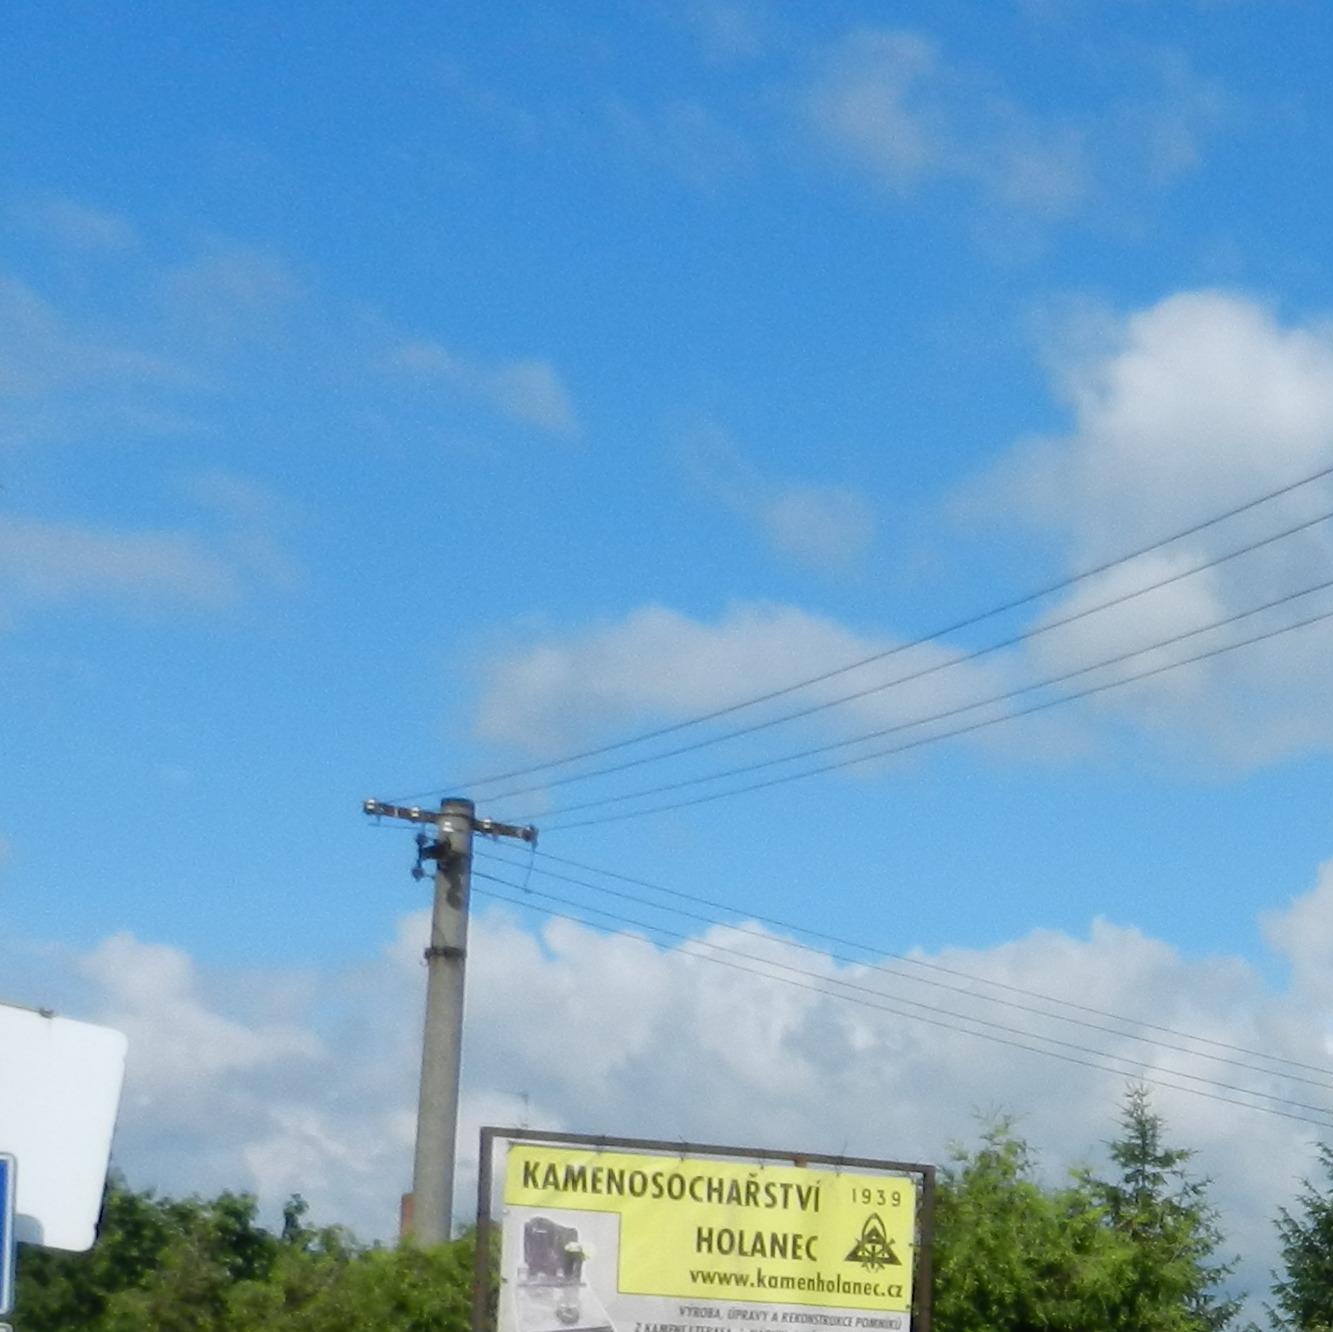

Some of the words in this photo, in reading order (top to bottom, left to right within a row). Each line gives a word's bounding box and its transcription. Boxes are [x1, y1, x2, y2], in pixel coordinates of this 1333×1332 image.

[522, 1160, 821, 1213] KAMENOSOCHAŘSTVÍ
[851, 1187, 902, 1207] 1939
[695, 1226, 819, 1262] HOLANEC
[770, 1312, 778, 1322] A
